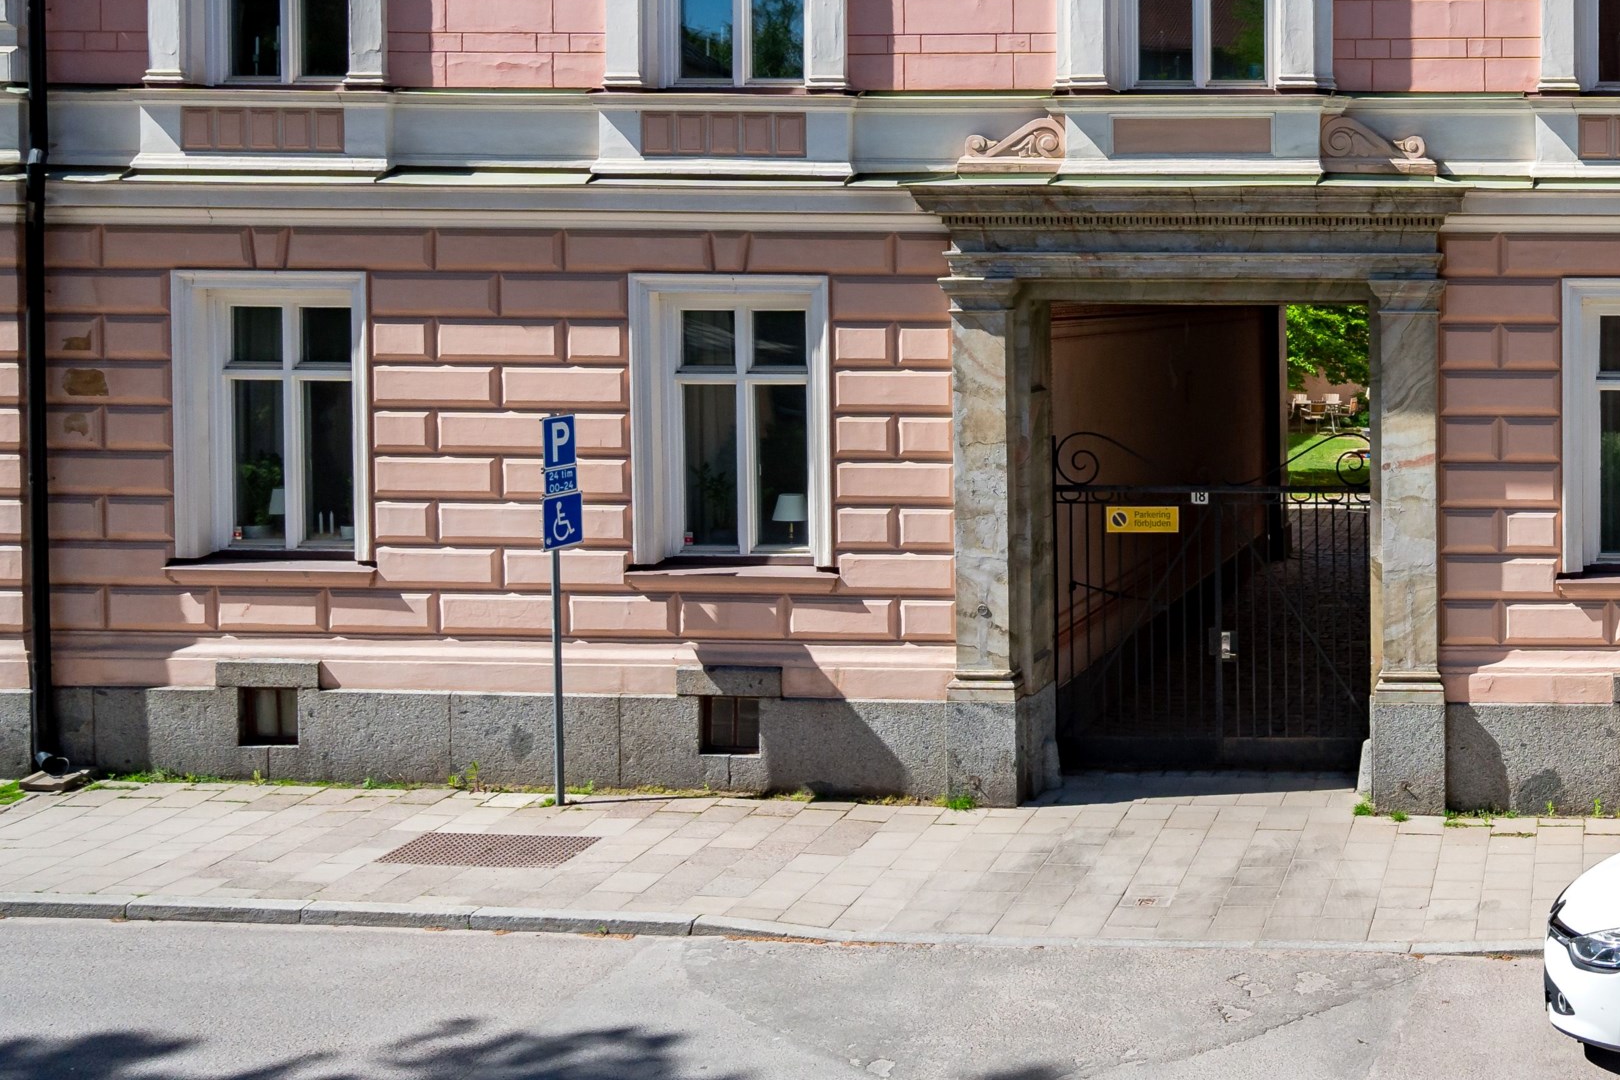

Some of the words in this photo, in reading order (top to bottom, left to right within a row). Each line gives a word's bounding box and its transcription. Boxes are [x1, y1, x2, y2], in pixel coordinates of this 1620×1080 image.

[551, 421, 570, 462] P
[549, 472, 559, 481] 24
[549, 480, 574, 493] 00-24
[1194, 492, 1206, 502] 18
[1134, 510, 1171, 520] Parkering
[1134, 519, 1171, 528] förbjuden
